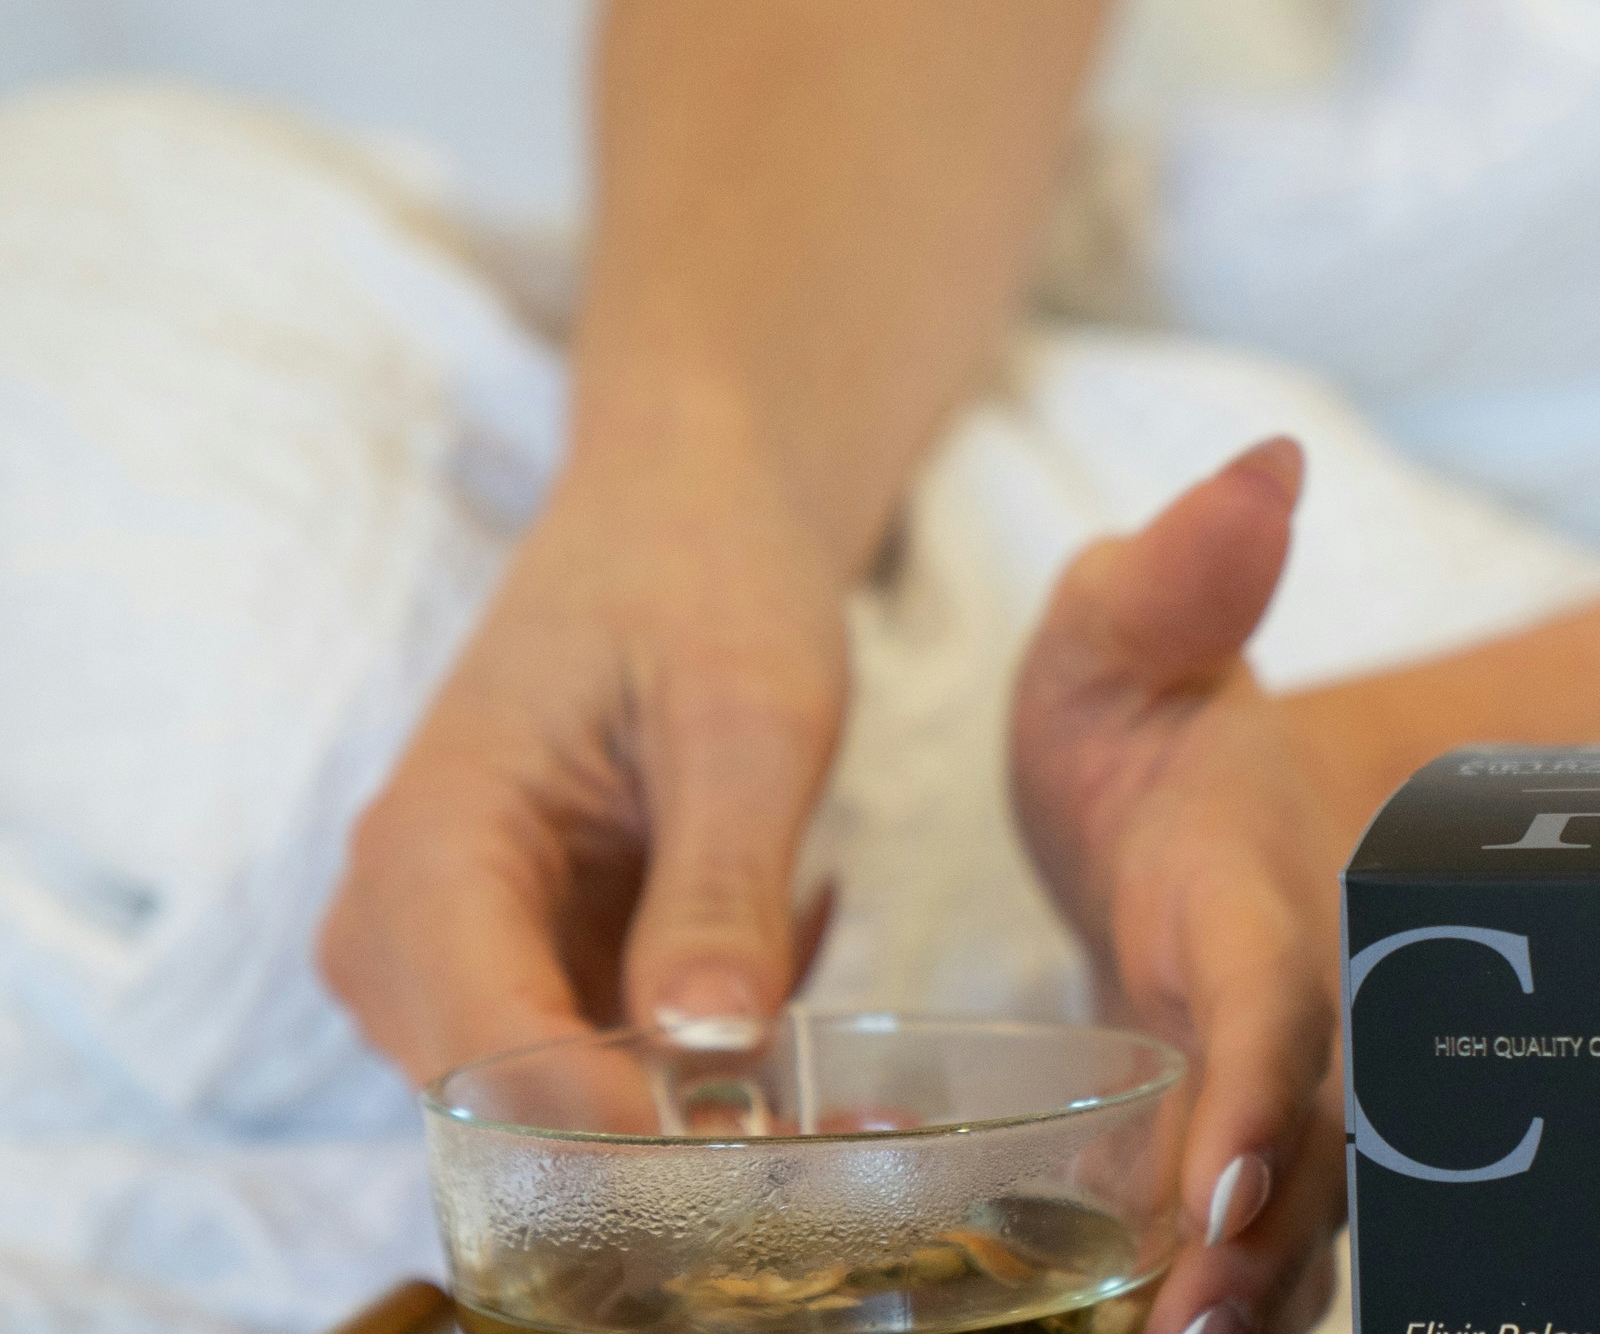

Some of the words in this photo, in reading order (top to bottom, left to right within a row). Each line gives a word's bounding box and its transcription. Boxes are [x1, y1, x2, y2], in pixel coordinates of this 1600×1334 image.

[1348, 924, 1545, 1184] C
[1434, 1036, 1488, 1057] HIGH
[1493, 1036, 1584, 1059] QUALITY
